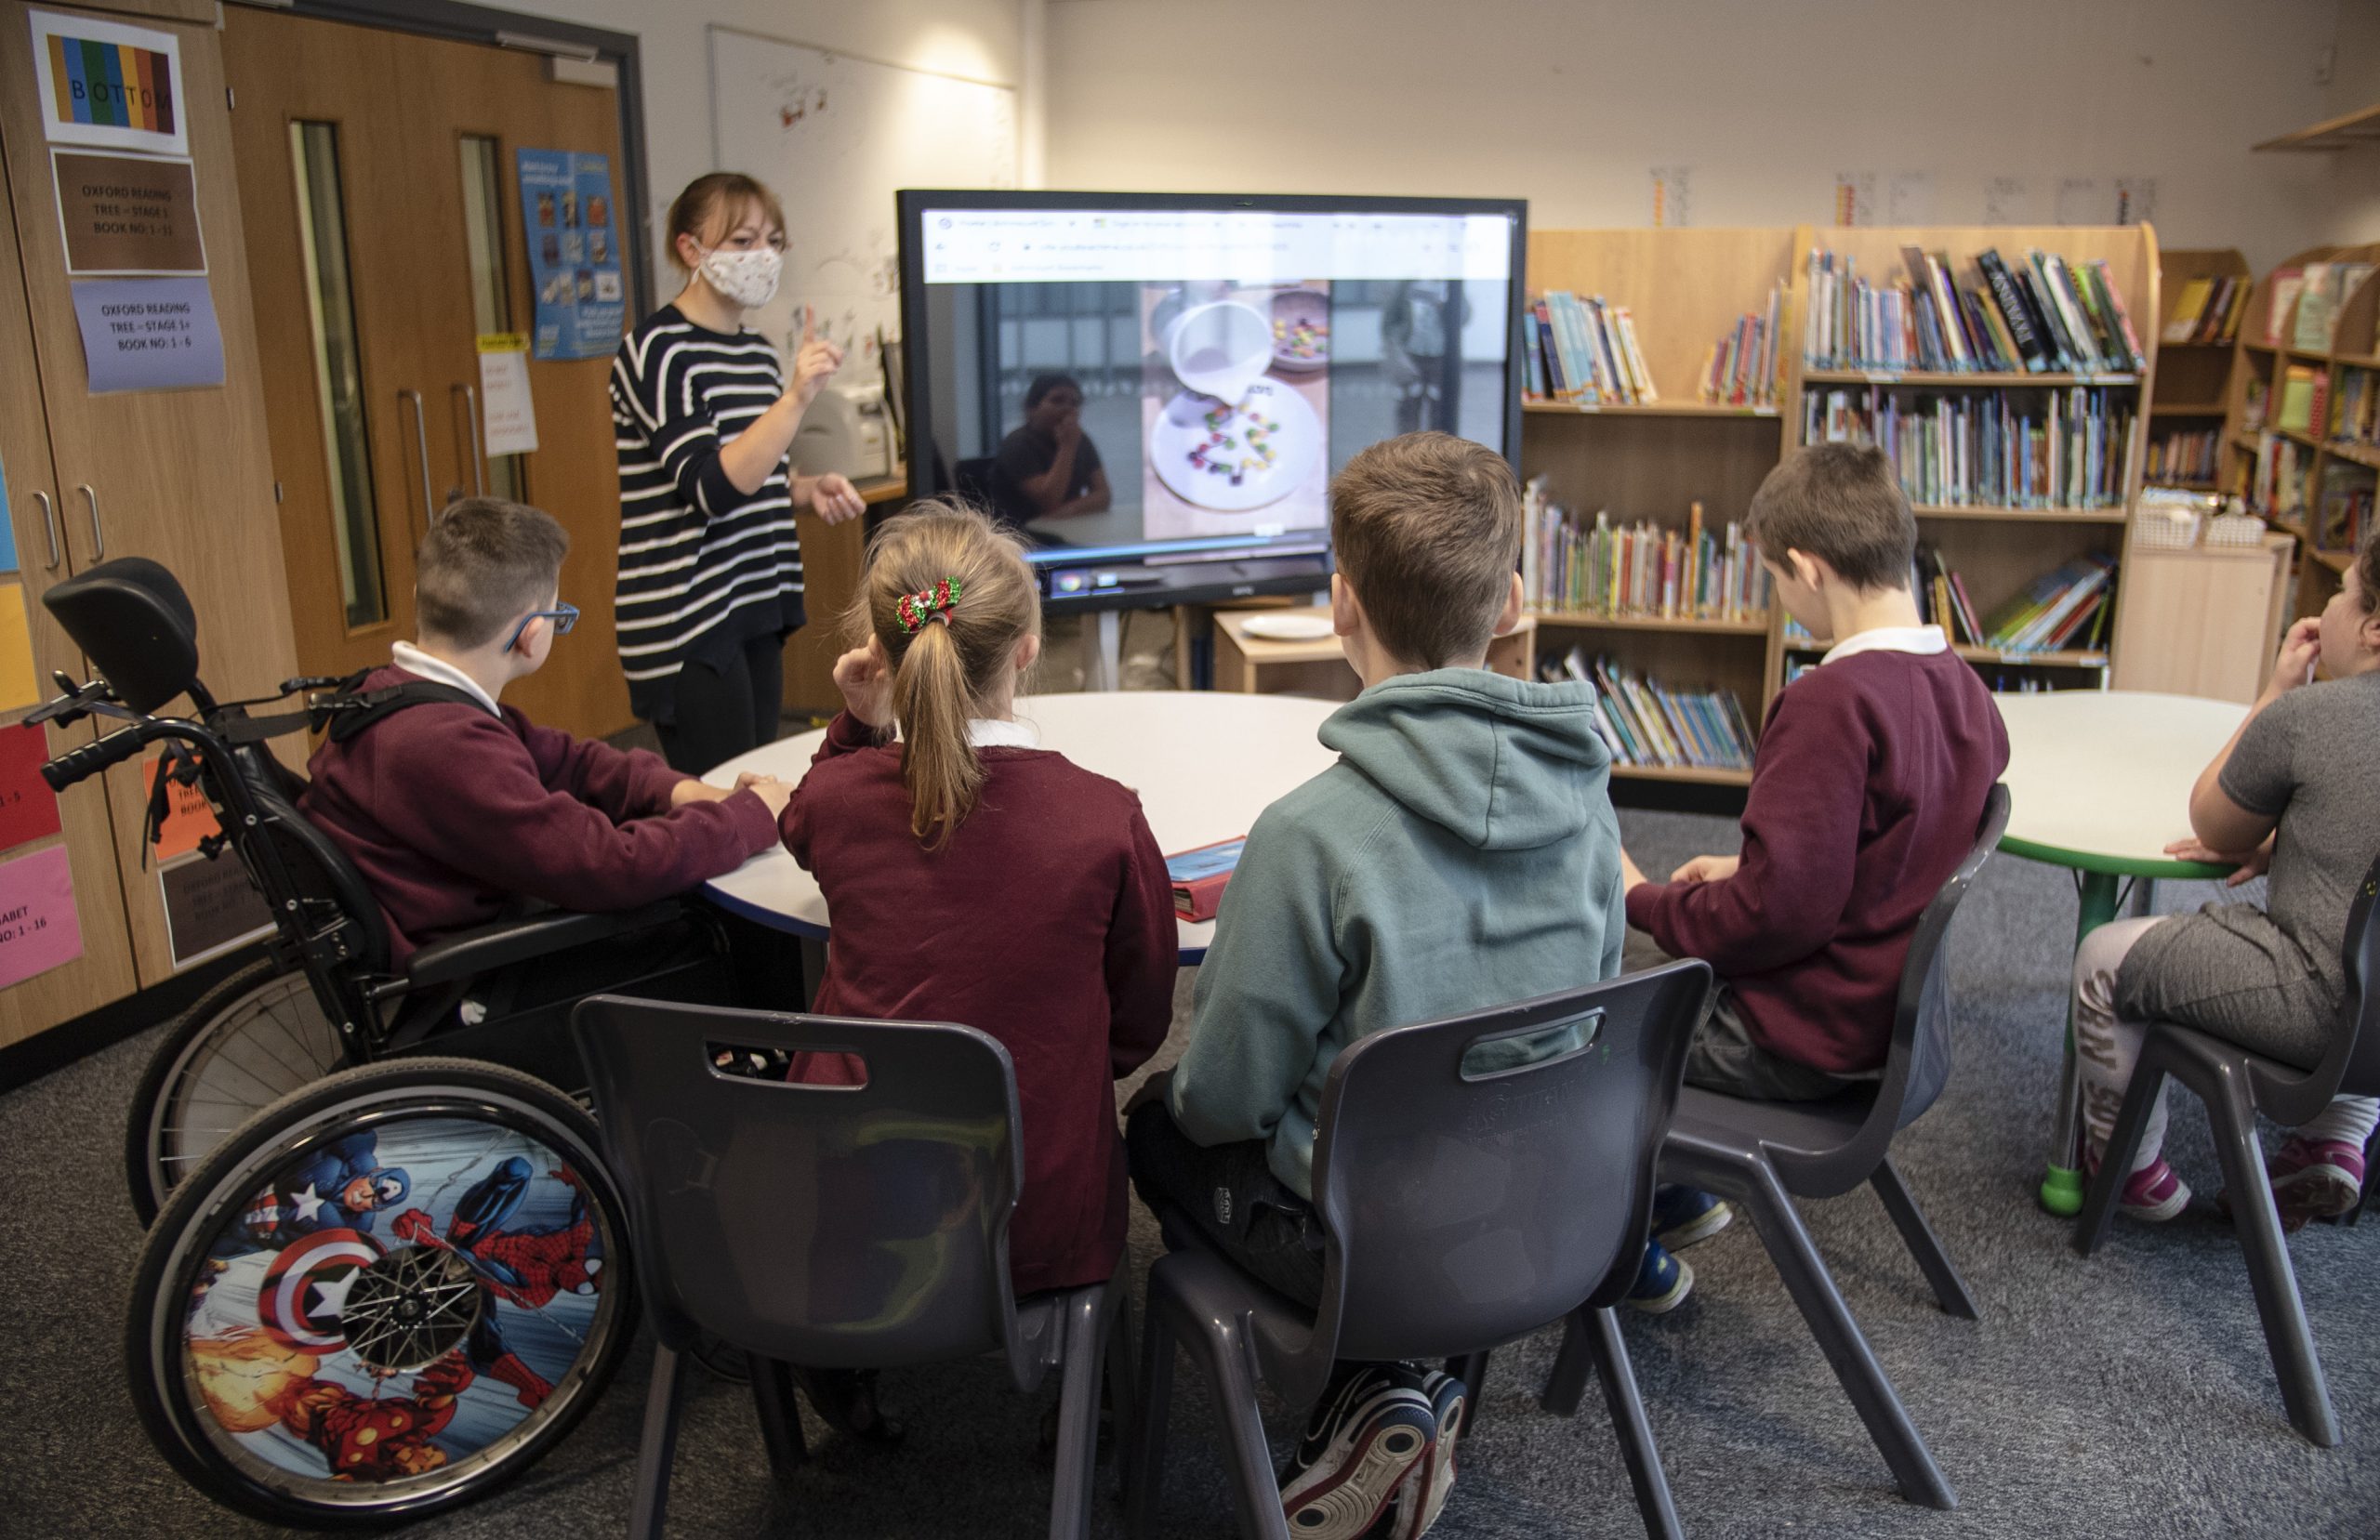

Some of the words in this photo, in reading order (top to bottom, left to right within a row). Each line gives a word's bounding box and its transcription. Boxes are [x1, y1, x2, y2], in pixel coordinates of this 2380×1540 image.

[82, 184, 129, 198] OXFORD
[131, 186, 171, 202] READING
[94, 204, 120, 217] TREE
[132, 206, 160, 218] STAGE
[94, 222, 126, 234] BOOK
[101, 303, 144, 317] OXFORD
[146, 303, 191, 316] READING
[110, 321, 135, 334] TREE
[145, 320, 176, 333] STAGE
[118, 338, 148, 351] BOOK
[0, 905, 27, 926] ABET
